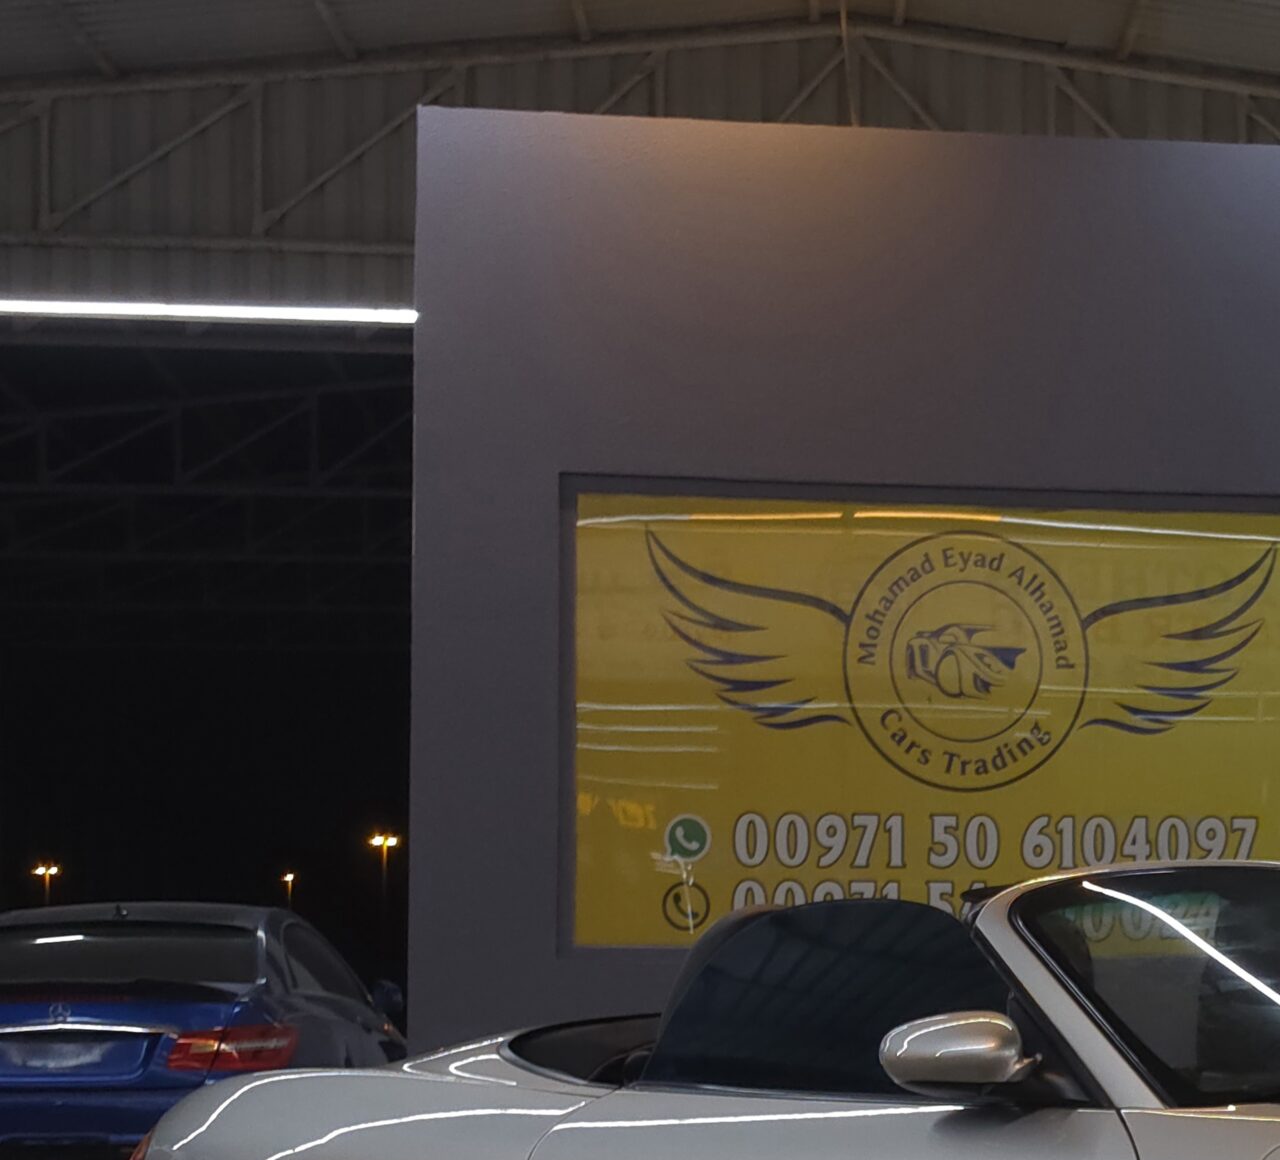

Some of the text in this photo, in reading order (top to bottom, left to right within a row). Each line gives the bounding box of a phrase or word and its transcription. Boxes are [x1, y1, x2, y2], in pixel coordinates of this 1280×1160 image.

[857, 546, 1076, 671] Mohamad Eyad Alhamad
[879, 707, 1052, 777] Cars Trading
[733, 812, 1258, 869] 00971 50 6104097
